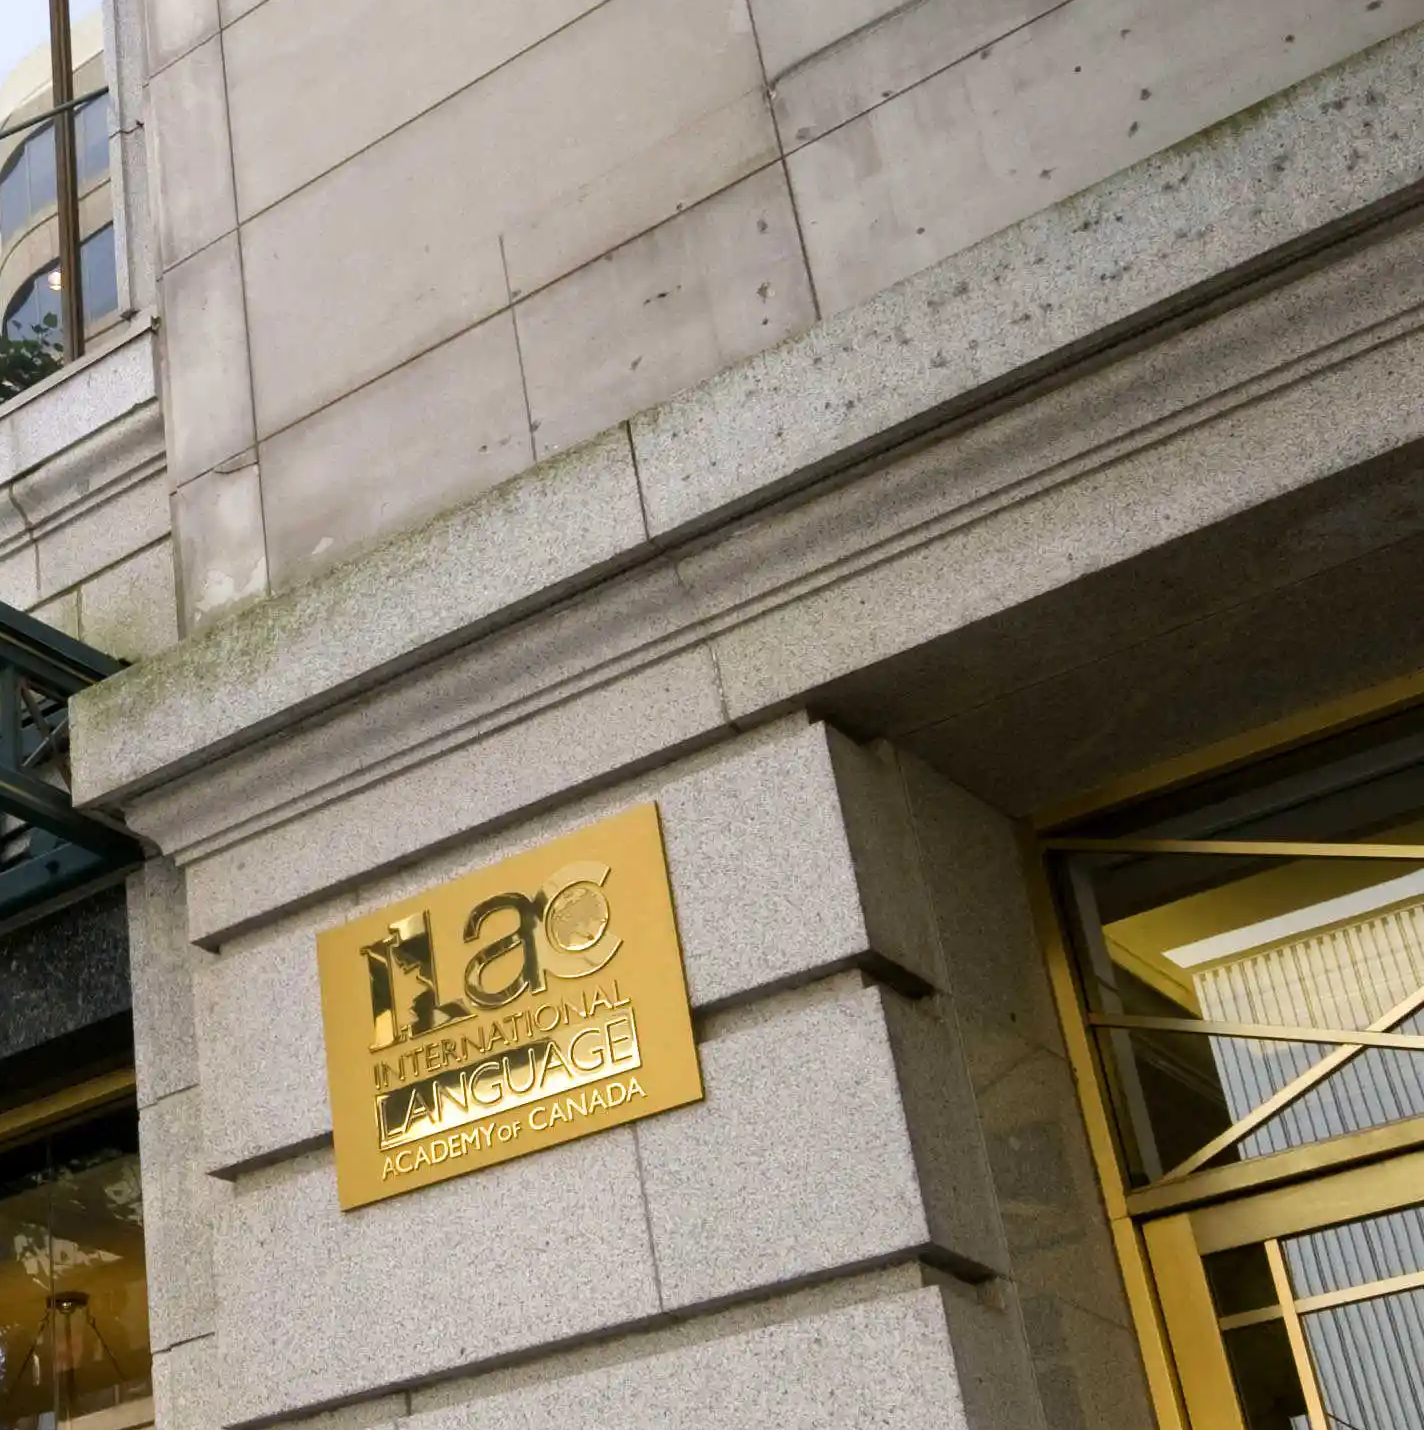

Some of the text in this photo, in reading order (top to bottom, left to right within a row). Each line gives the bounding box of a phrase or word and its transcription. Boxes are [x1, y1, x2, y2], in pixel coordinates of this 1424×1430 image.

[373, 978, 631, 1090] INTERNATIONAL
[377, 1015, 636, 1143] LANGUAGE
[381, 1122, 495, 1181] ACADEMY
[528, 1076, 648, 1131] CANADA
